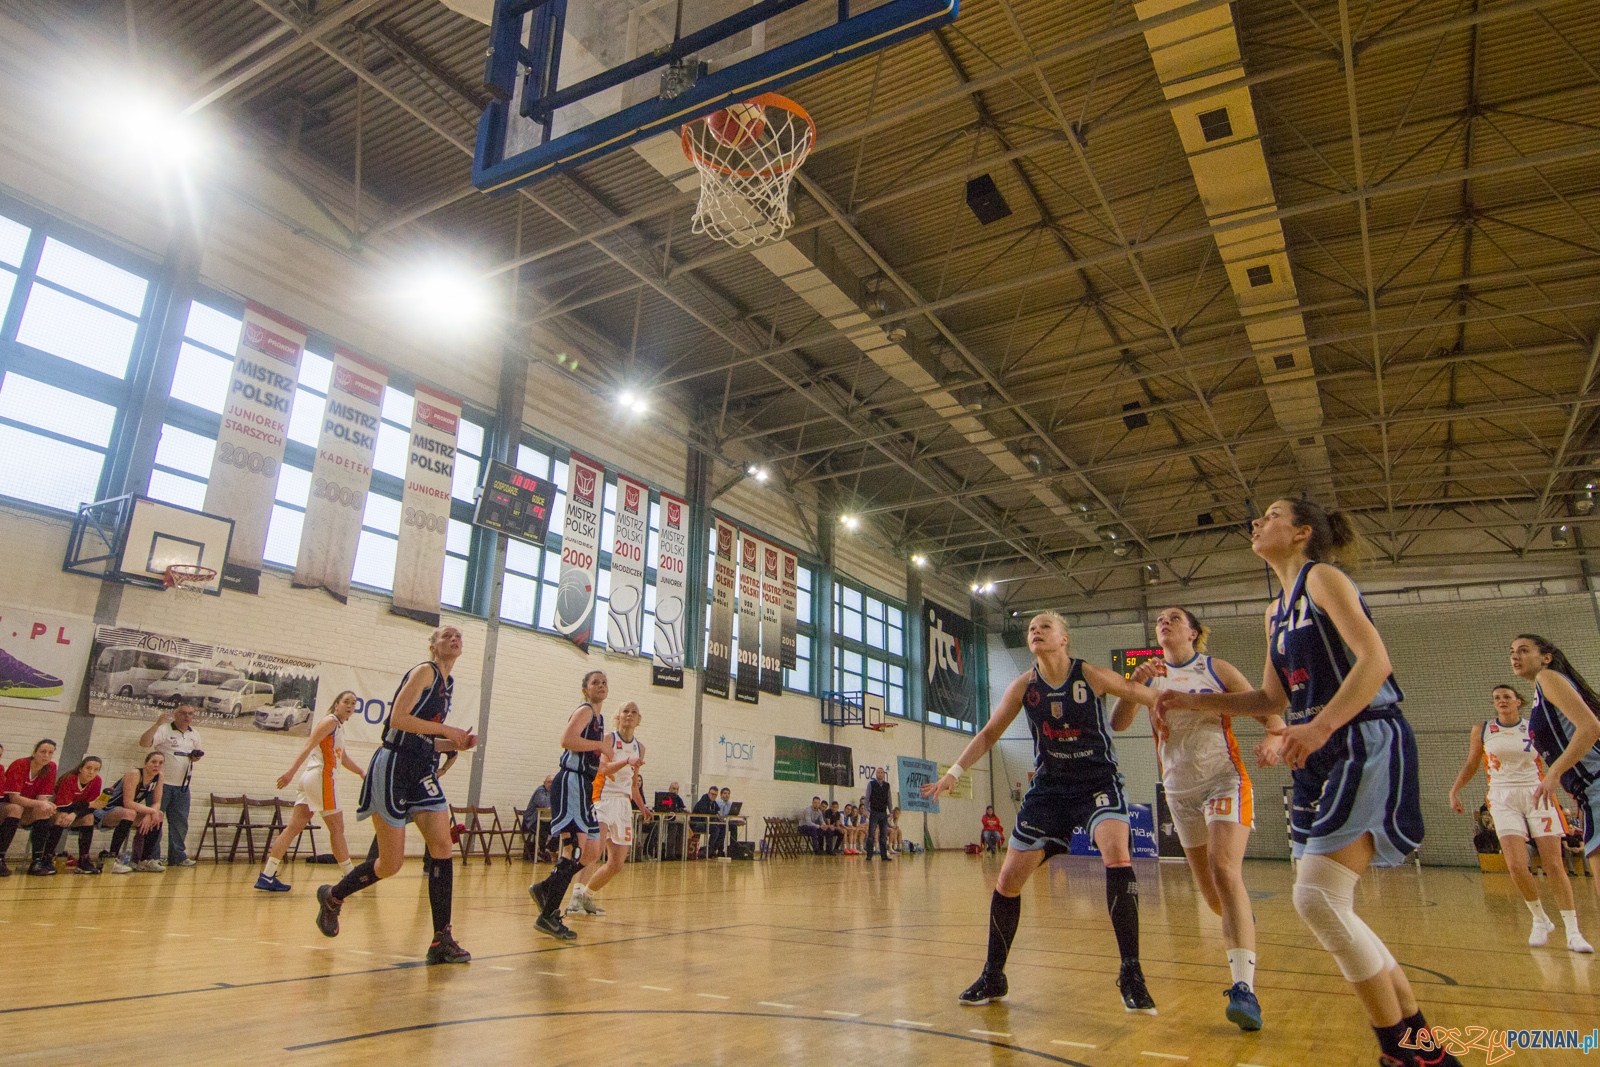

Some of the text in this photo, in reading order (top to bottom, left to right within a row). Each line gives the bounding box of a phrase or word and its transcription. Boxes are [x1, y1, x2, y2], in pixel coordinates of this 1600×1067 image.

[267, 338, 296, 355] PROKOM
[237, 358, 294, 393] MISTRZ
[232, 379, 290, 414] POLSKI
[354, 380, 380, 396] PROKOM
[228, 404, 285, 433] JUNIOREK
[328, 399, 379, 431] MISTRZ
[433, 413, 455, 426] PROKOM
[224, 419, 283, 447] STARSZYCH
[324, 419, 376, 451] POLSKI
[413, 434, 456, 459] MISTRZ
[218, 442, 277, 478] 2008
[319, 449, 370, 476] KADETEK
[410, 451, 453, 478] POLSKI
[313, 477, 364, 511] 2008
[407, 481, 450, 501] JUNIOREK
[493, 479, 519, 497] GOSPODARZE
[404, 506, 447, 535] 2008
[566, 503, 597, 526] MISTRZ
[616, 512, 644, 532] MISTRZ
[565, 517, 596, 539] POLSKI
[615, 525, 644, 545] POLSKI
[660, 528, 685, 546] MISTRZ
[564, 536, 594, 550] JUNIOREK
[615, 539, 641, 562] 2010
[660, 540, 685, 557] POLSKI
[562, 546, 593, 570] 2009
[659, 554, 684, 574] 2010
[611, 561, 643, 578] MŁODZICZEK
[660, 576, 683, 588] JUNIOREK
[715, 574, 734, 590] OLSKI
[739, 573, 760, 589] MISTRZ
[739, 583, 760, 599] POLSKI
[762, 581, 782, 596] MISTRZ
[762, 592, 781, 606] POLSKI
[782, 588, 797, 599] POLSKI
[137, 635, 178, 654] AGMA
[708, 640, 729, 660] 2011
[781, 636, 796, 647] 2013
[216, 646, 317, 669] TRANSPORT MIĘDZYNARODOWY
[252, 661, 284, 671] KRAJOWY
[738, 648, 758, 667] 2012
[761, 655, 781, 673] 2012
[1126, 657, 1137, 666] 50
[1072, 680, 1087, 704] 6
[353, 697, 394, 725] PO
[725, 740, 755, 762] posir
[1522, 739, 1533, 752] 7
[1093, 791, 1110, 807] 6
[1208, 796, 1232, 816] 10
[624, 827, 631, 841] 5
[1541, 817, 1553, 833] 7
